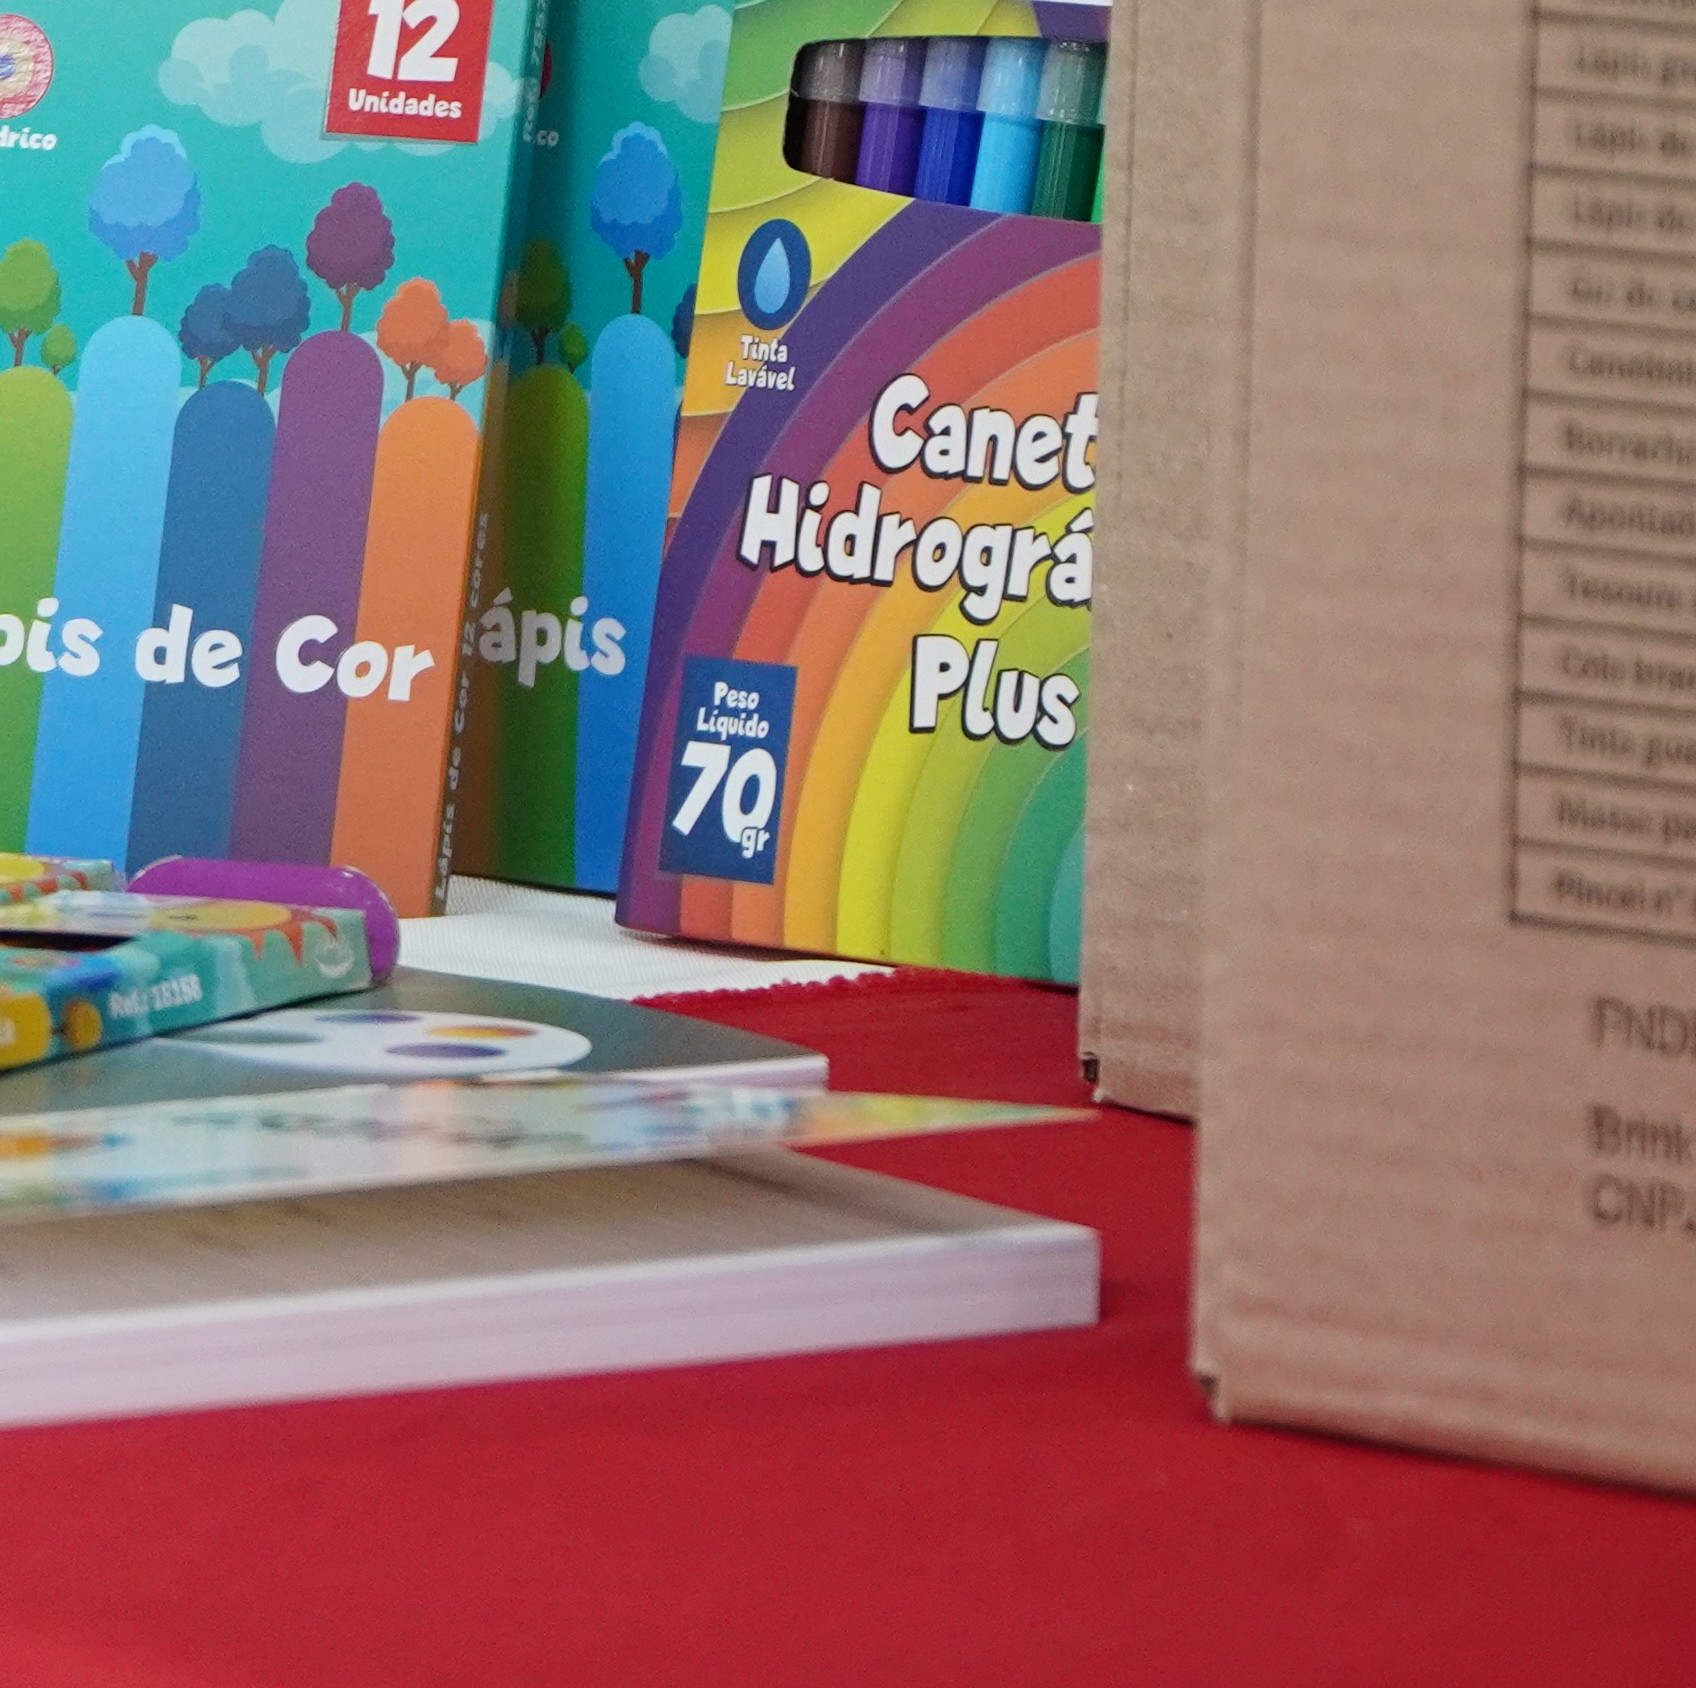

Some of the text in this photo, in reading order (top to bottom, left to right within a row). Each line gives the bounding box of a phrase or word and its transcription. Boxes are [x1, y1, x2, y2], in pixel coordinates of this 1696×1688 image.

[347, 87, 464, 121] Unidades
[739, 335, 789, 364] Tinta
[724, 361, 797, 392] Lavável
[134, 603, 244, 689] de
[276, 615, 437, 704] Cor
[713, 681, 760, 711] Peso
[909, 634, 1082, 751] Plus
[696, 707, 770, 741] Líquido
